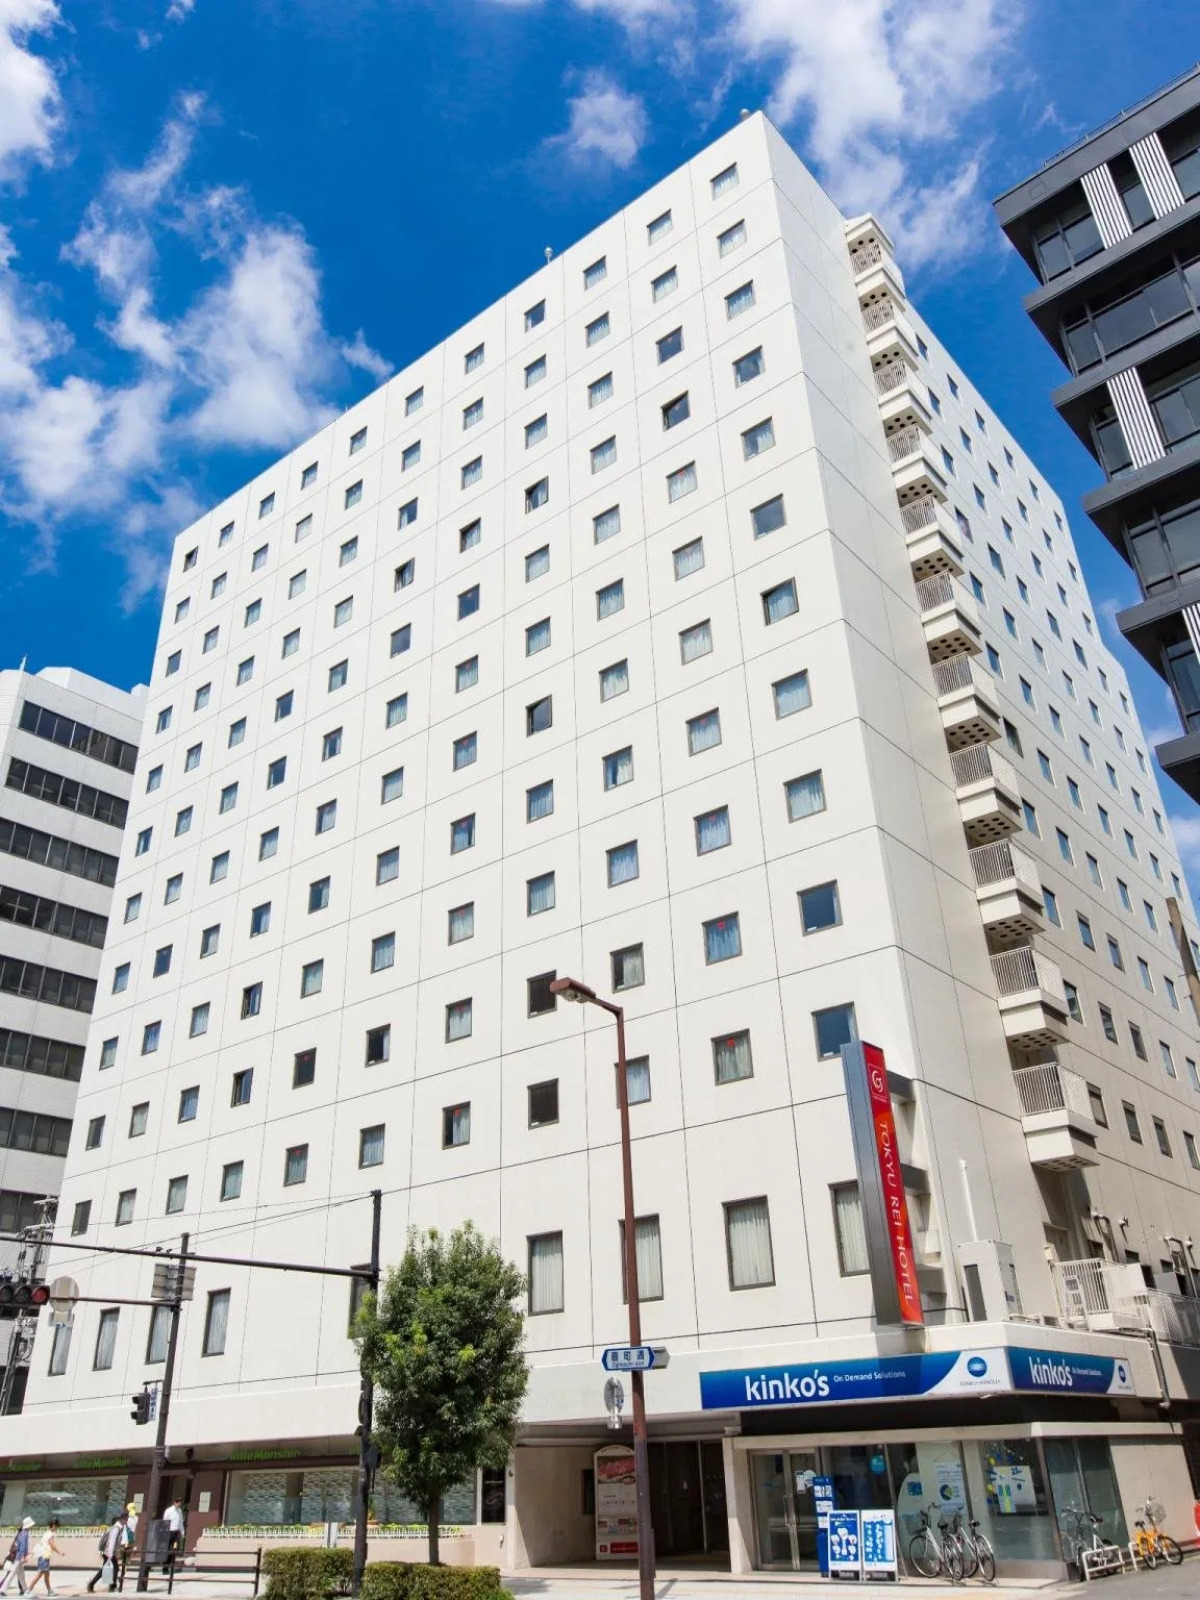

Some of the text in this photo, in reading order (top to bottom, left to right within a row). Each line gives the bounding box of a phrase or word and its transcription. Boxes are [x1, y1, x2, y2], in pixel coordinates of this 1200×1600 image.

[879, 1120, 914, 1304] TOKYU REI HOTEL
[745, 1369, 830, 1401] kinko's
[845, 1372, 873, 1381] Demand
[873, 1370, 906, 1380] Solutions
[1028, 1356, 1073, 1387] kinko's
